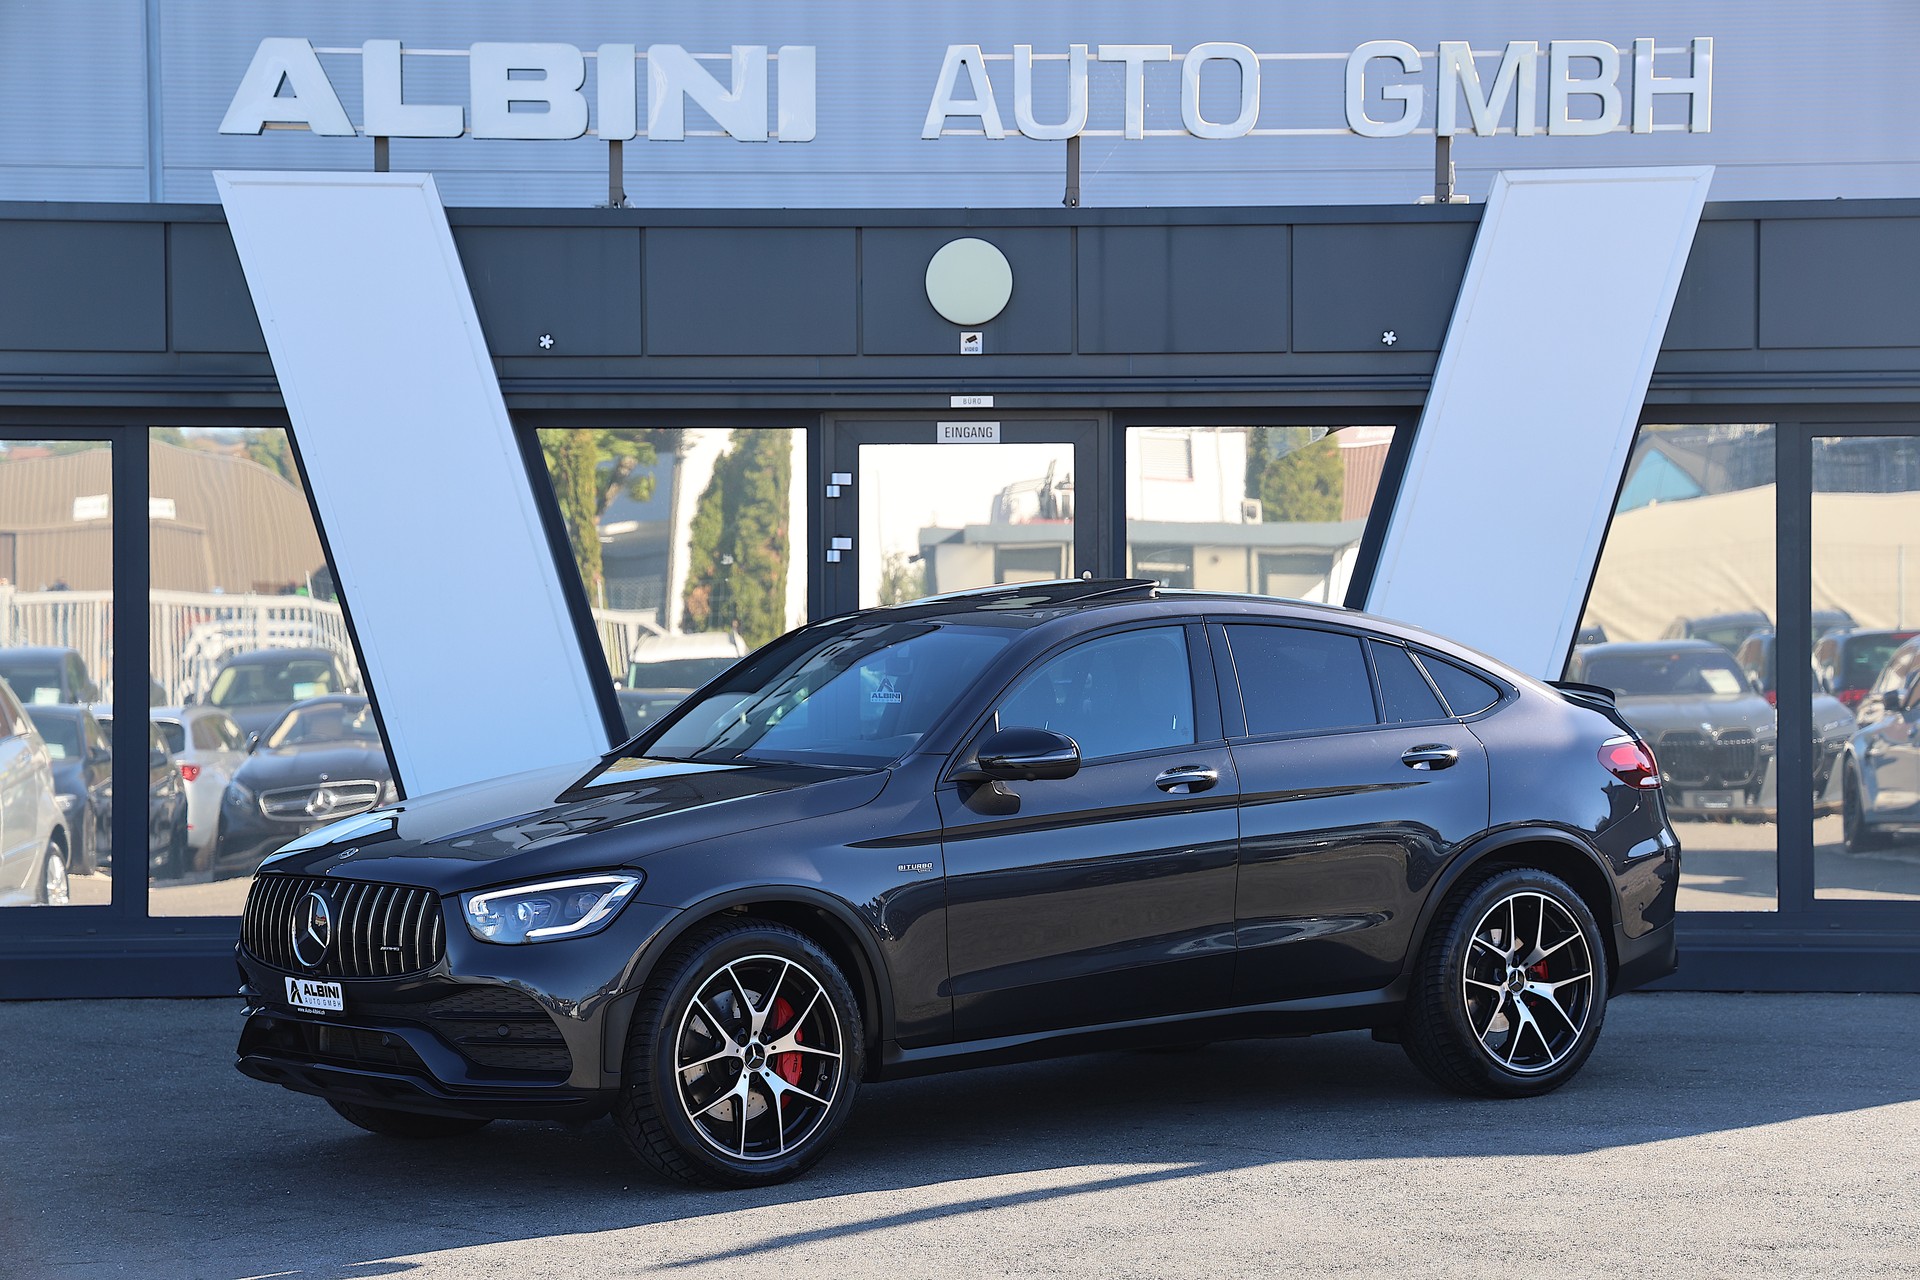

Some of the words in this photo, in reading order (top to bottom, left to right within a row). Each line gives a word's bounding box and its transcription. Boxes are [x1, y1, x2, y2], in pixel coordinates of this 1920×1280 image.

[218, 37, 817, 142] ALBINI
[921, 41, 1262, 141] AUTO
[1344, 37, 1714, 138] GMBH
[962, 397, 982, 405] BÜRO
[944, 426, 993, 438] EINGANG
[304, 983, 340, 999] ALBINI
[304, 997, 321, 1006] AUTO
[323, 999, 342, 1008] GMBH
